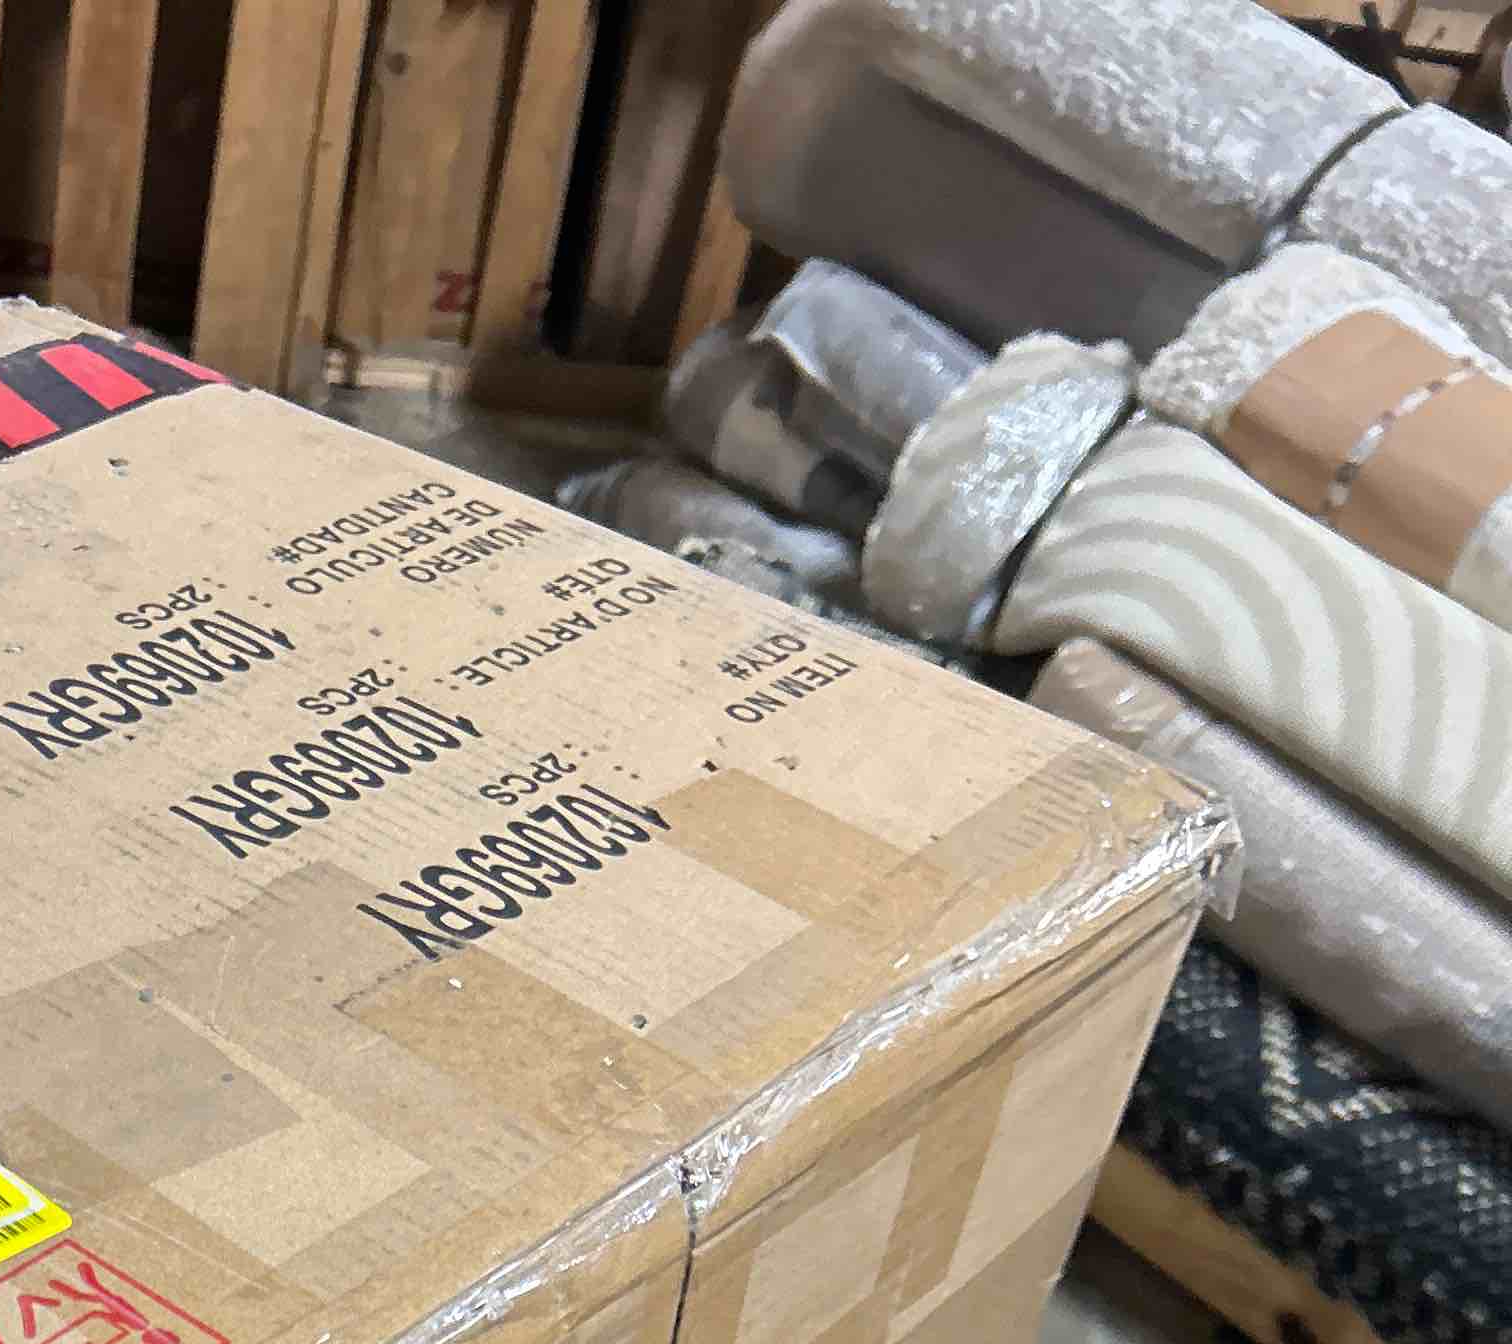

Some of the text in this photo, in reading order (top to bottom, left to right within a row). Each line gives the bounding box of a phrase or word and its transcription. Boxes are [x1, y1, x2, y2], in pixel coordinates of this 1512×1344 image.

[272, 483, 455, 563] CANTIDAD#
[443, 500, 502, 526] DE
[286, 517, 451, 594] ARTÍCULO
[400, 519, 544, 583] NÚMERO
[542, 559, 630, 601] QTÉ#
[619, 576, 679, 604] NO
[115, 584, 212, 629] 2PCS
[718, 634, 806, 680] QTY#
[769, 653, 858, 698] ITEM
[297, 668, 394, 715] 2PCS
[725, 691, 787, 723] NO
[169, 696, 483, 859] 102069GRY
[479, 752, 576, 805] 2PCS
[356, 784, 672, 963] 102069GRY
